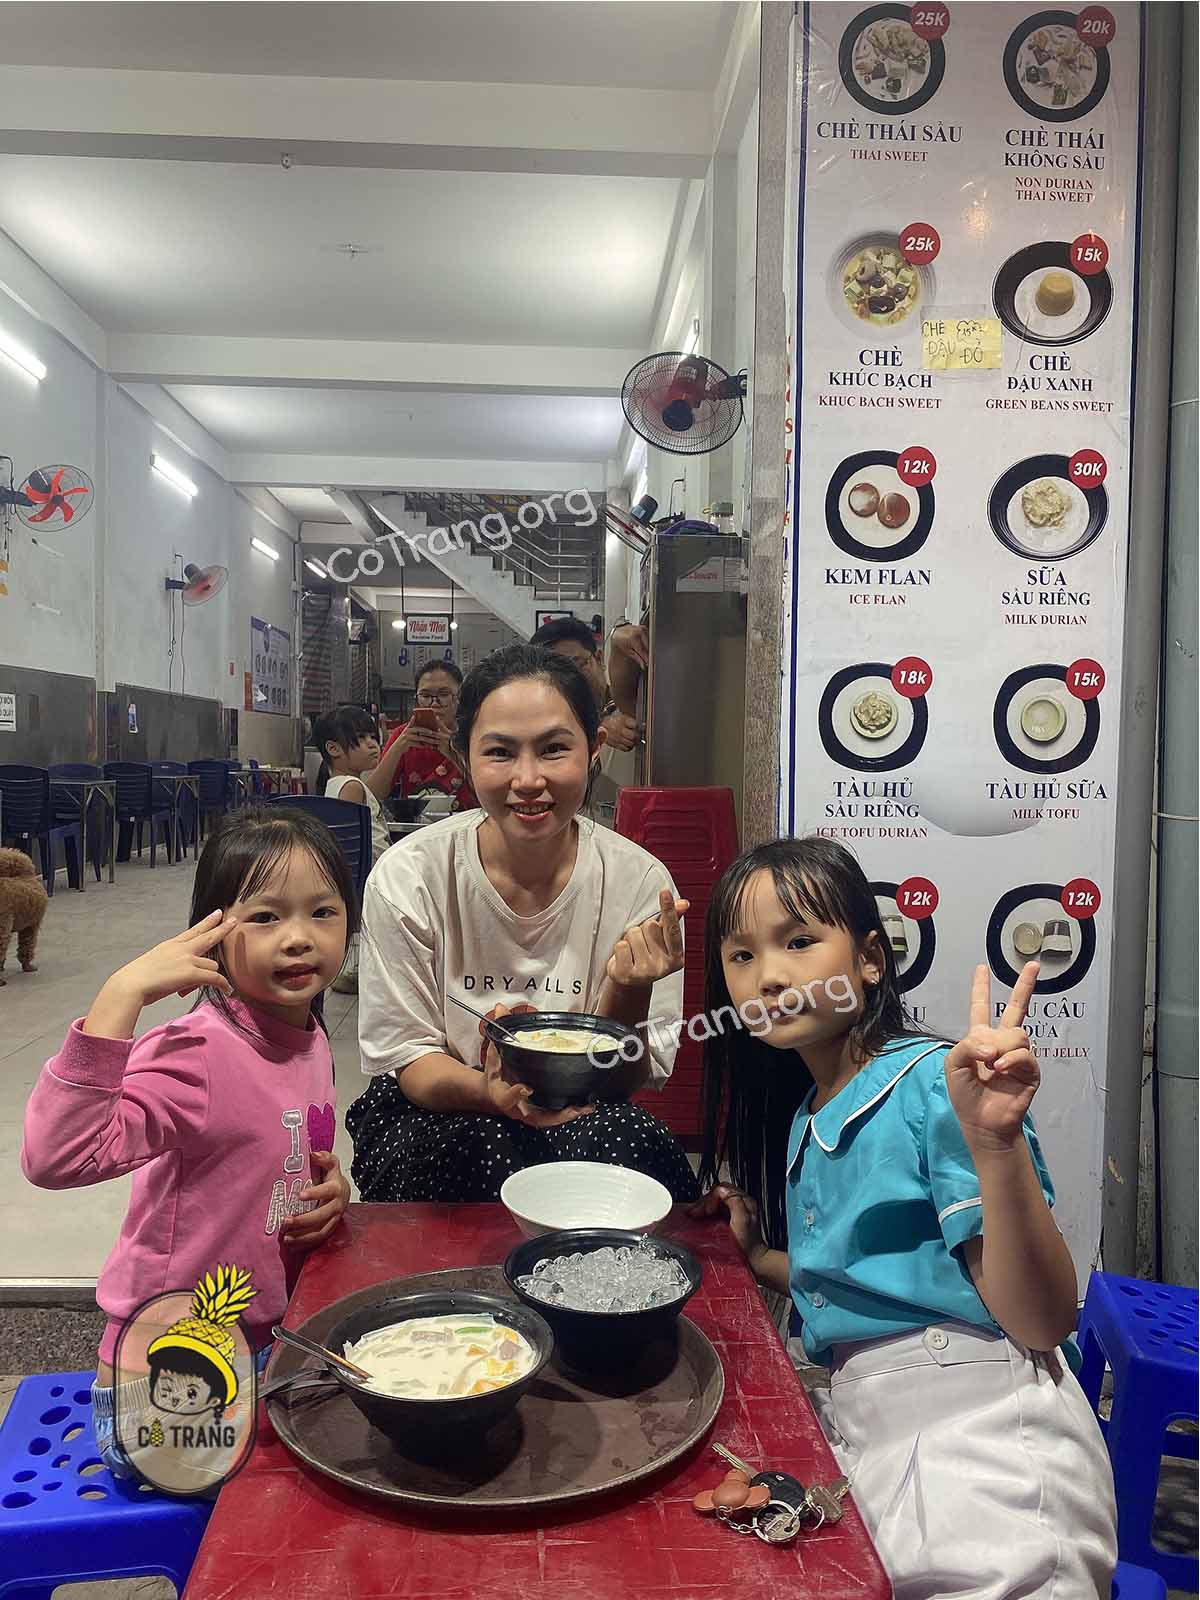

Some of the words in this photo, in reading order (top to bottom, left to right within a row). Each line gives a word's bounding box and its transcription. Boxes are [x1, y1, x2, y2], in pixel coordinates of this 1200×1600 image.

[816, 117, 860, 139] CHÈ
[866, 120, 917, 141] THÁI
[1005, 126, 1049, 147] CHÈ
[1055, 128, 1104, 149] THÁI
[850, 149, 881, 160] THAI
[884, 150, 928, 161] SWEET
[1004, 149, 1067, 168] KHÔNG
[1015, 177, 1041, 188] NON
[1045, 178, 1093, 190] DURIAN
[1016, 190, 1045, 201] THAI
[1049, 191, 1093, 203] SWEET
[905, 237, 934, 251] 25k
[1077, 248, 1102, 262] 15k
[859, 346, 904, 367] CHÈ
[1029, 353, 1072, 372] CHÈ
[828, 368, 880, 387] KHÚC
[884, 373, 933, 390] BẠCH
[1007, 375, 1042, 393] ĐẬU
[1046, 378, 1093, 392] XANH
[818, 396, 855, 408] KHUC
[858, 396, 896, 409] BACH
[897, 397, 942, 410] SWEET
[985, 398, 1027, 411] GREEN
[1031, 399, 1070, 412] BEANS
[1072, 401, 1114, 413] SWEET
[903, 460, 930, 475] 12k
[825, 569, 871, 585] KEM
[878, 569, 931, 585] FLAN
[1027, 566, 1067, 586] SỮA
[849, 594, 870, 605] ICE
[874, 595, 906, 606] FLAN
[1039, 588, 1091, 605] RIÊNG
[1005, 614, 1037, 625] MILK
[1041, 615, 1087, 625] DURIAN
[899, 670, 926, 685] 18k
[1073, 672, 1100, 687] 15k
[833, 776, 875, 798] TÀU
[883, 777, 912, 798] HỦ
[986, 779, 1028, 799] TÀU
[1033, 777, 1064, 799] HỦ
[1067, 779, 1108, 800] SỮA
[864, 800, 920, 818] RIÊNG
[1012, 808, 1043, 819] MILK
[1045, 809, 1081, 819] TOFU
[816, 827, 838, 838] ICE
[841, 827, 875, 838] TOFU
[879, 827, 928, 838] DURIAN
[903, 891, 932, 906] 12k
[1068, 892, 1095, 907] 12k
[464, 975, 513, 991] DRY
[524, 975, 582, 994] ALLS
[1043, 997, 1086, 1018] CÂU
[1053, 1047, 1090, 1058] JELLY
